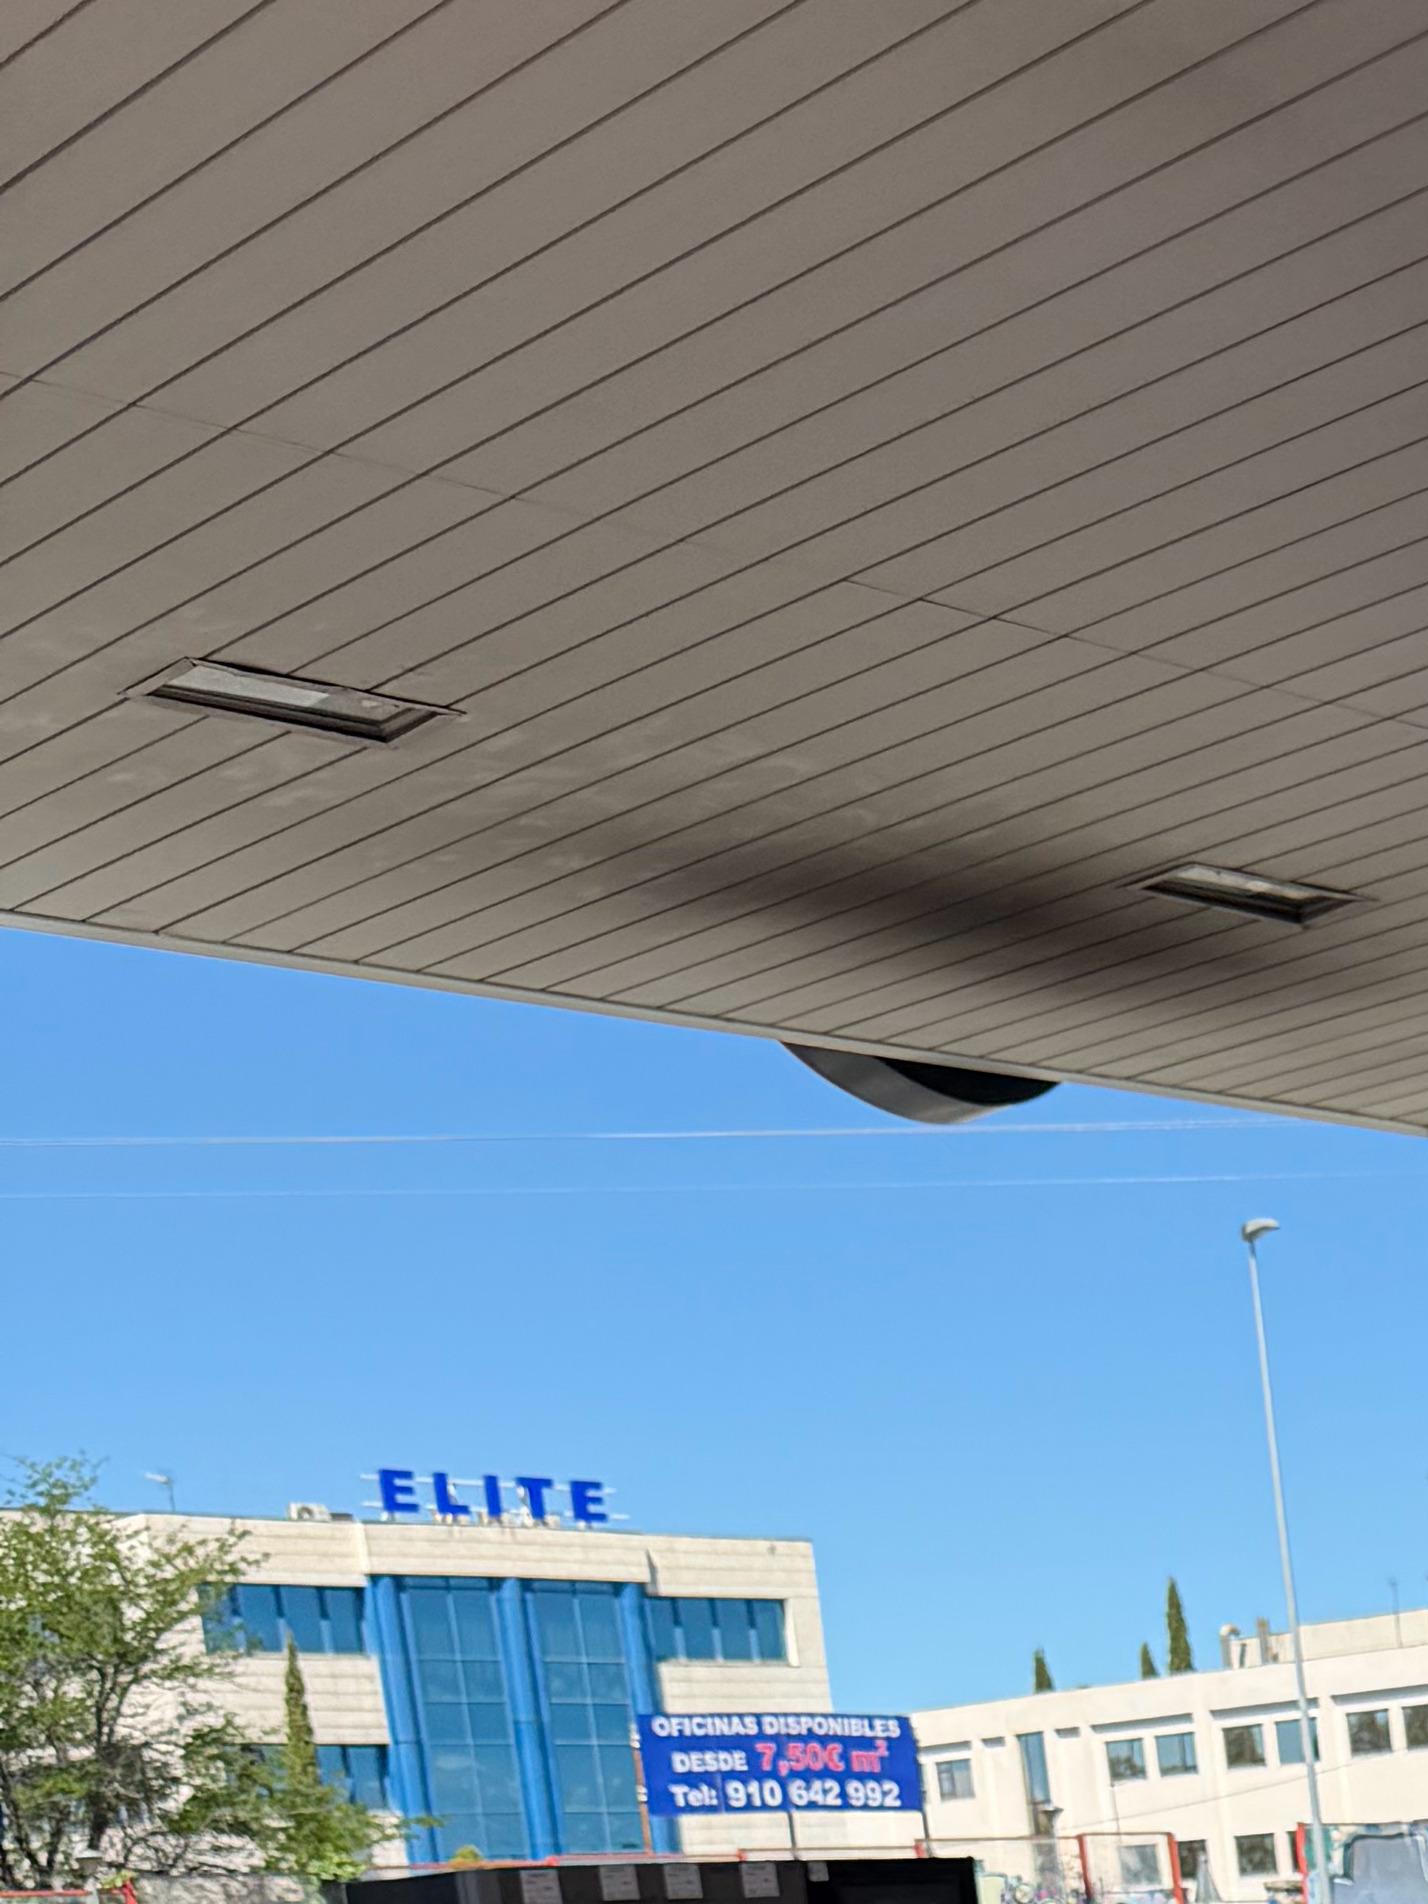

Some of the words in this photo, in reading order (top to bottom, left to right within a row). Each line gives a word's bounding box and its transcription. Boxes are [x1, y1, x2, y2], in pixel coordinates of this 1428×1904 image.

[378, 1469, 609, 1522] ELITE
[652, 1716, 758, 1737] OFICINAS
[762, 1716, 900, 1738] DISPONIBLES
[671, 1751, 748, 1773] DESDE
[755, 1743, 845, 1777] 7,50€
[668, 1783, 717, 1807] Tel:
[725, 1779, 782, 1808] 910
[789, 1780, 841, 1807] 642
[845, 1780, 901, 1808] 992
